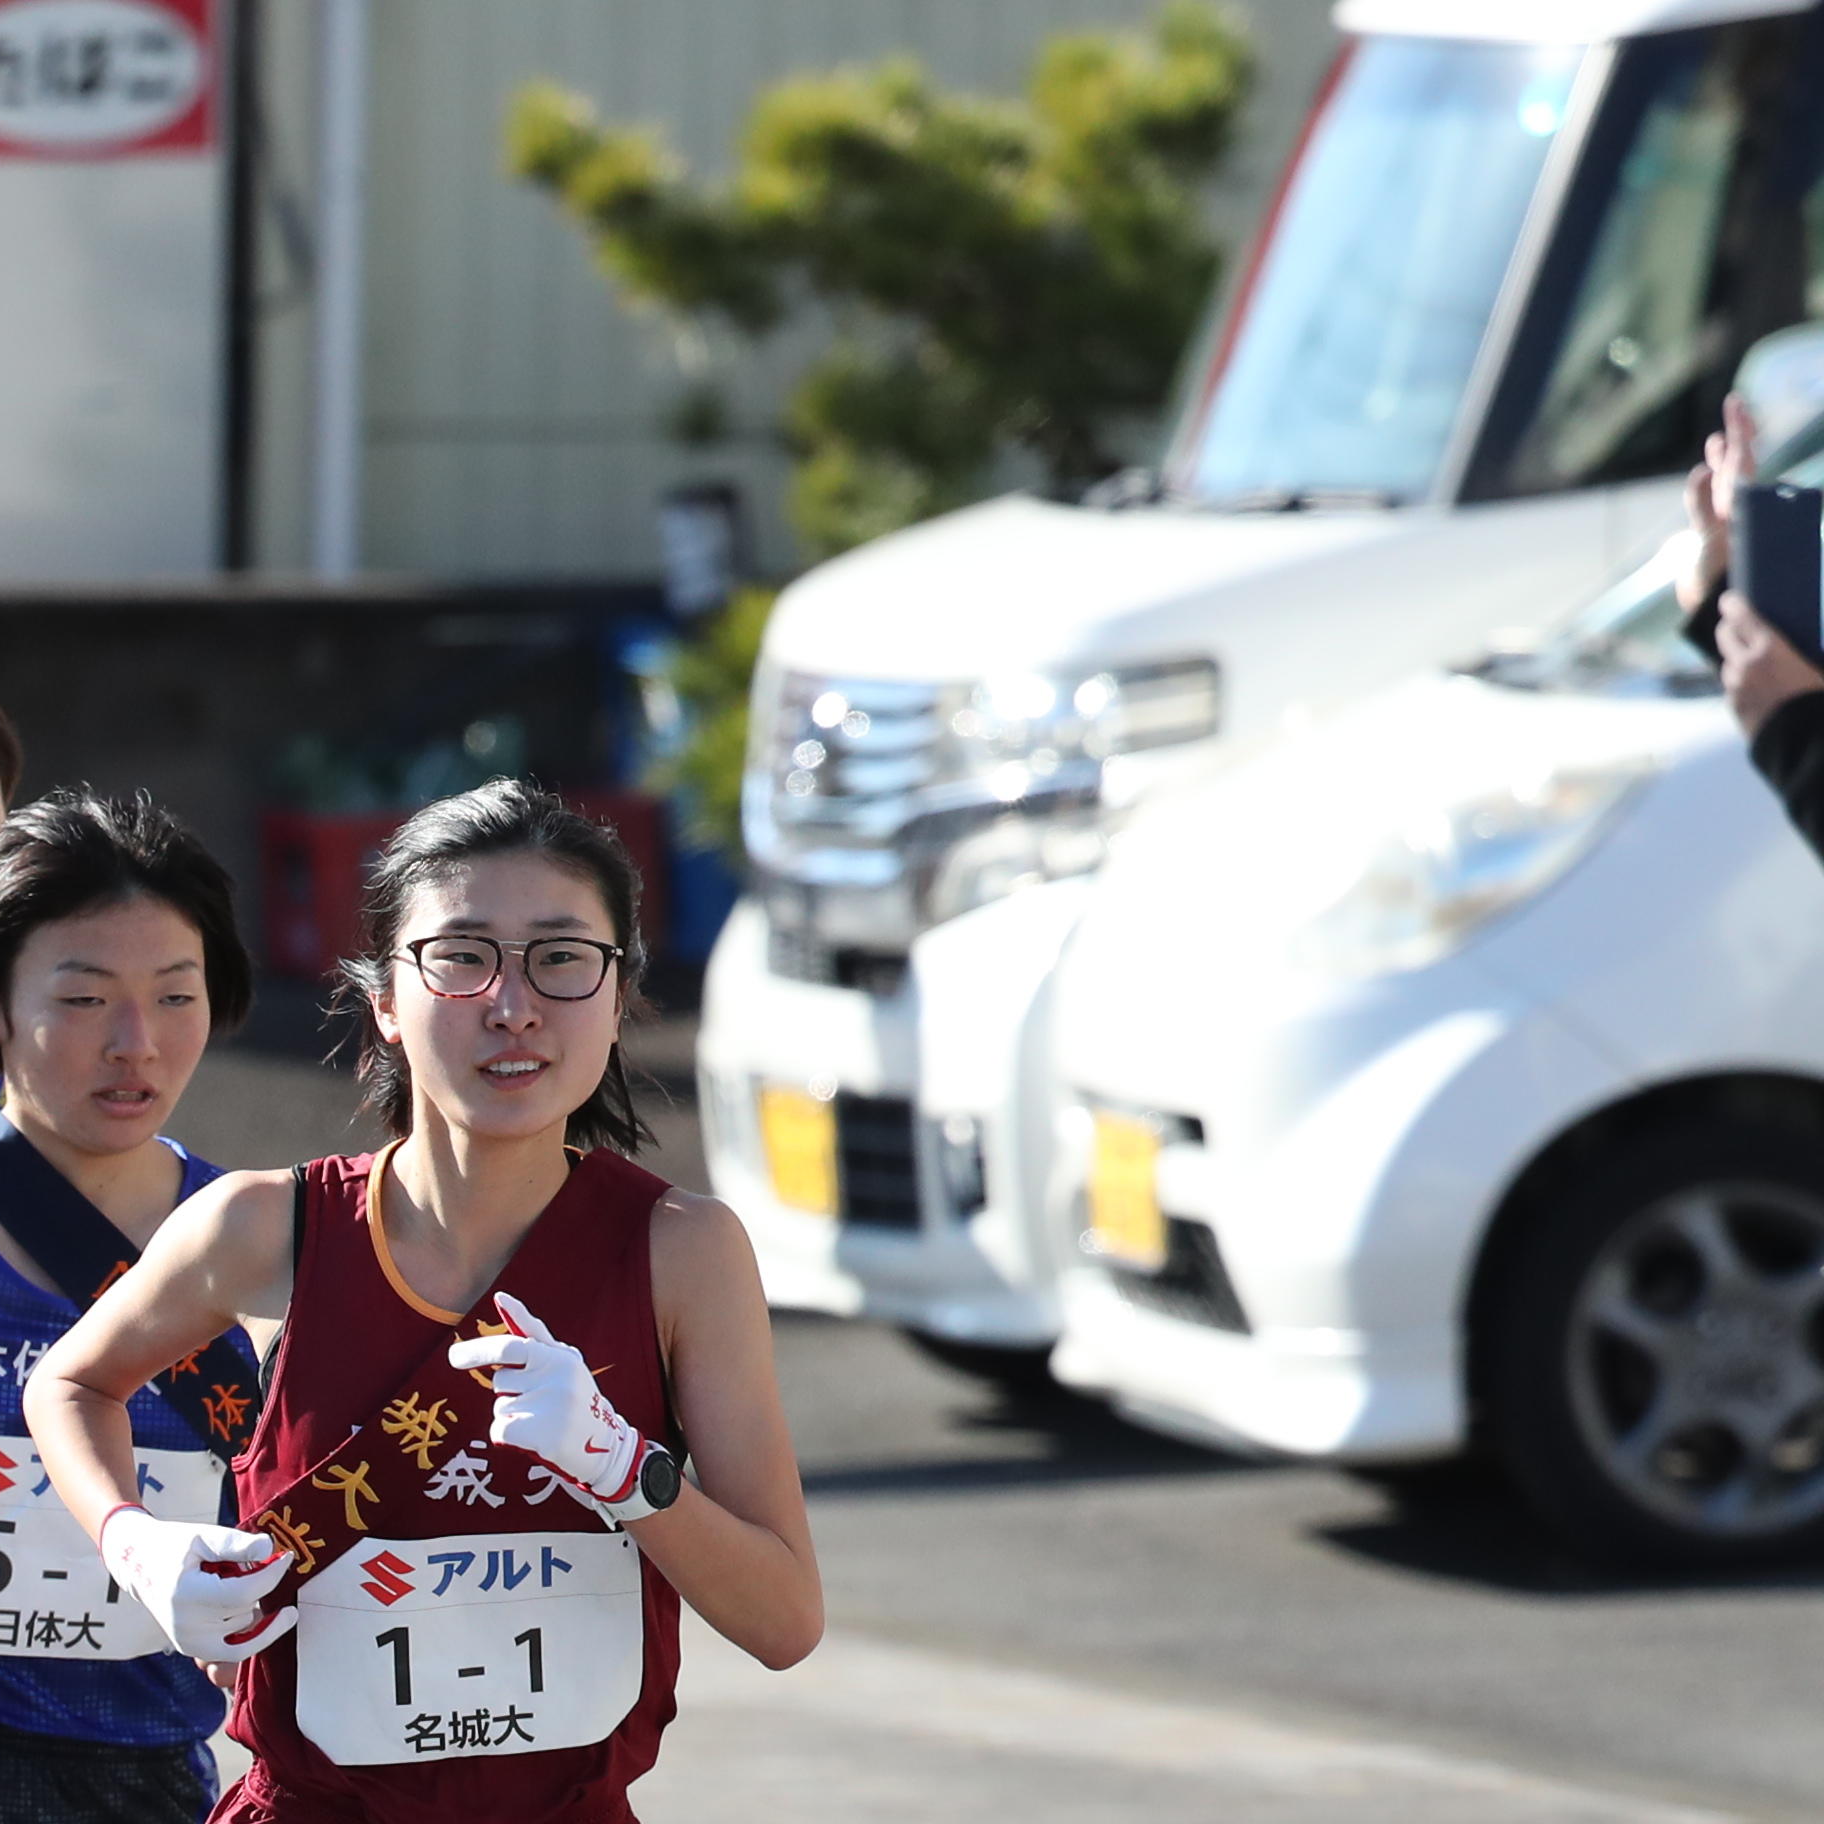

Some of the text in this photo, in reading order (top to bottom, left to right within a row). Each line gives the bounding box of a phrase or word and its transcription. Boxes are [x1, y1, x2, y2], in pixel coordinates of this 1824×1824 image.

[427, 1547, 573, 1597] アルト
[375, 1627, 544, 1706] 1-1
[404, 1705, 536, 1753] 名城大
